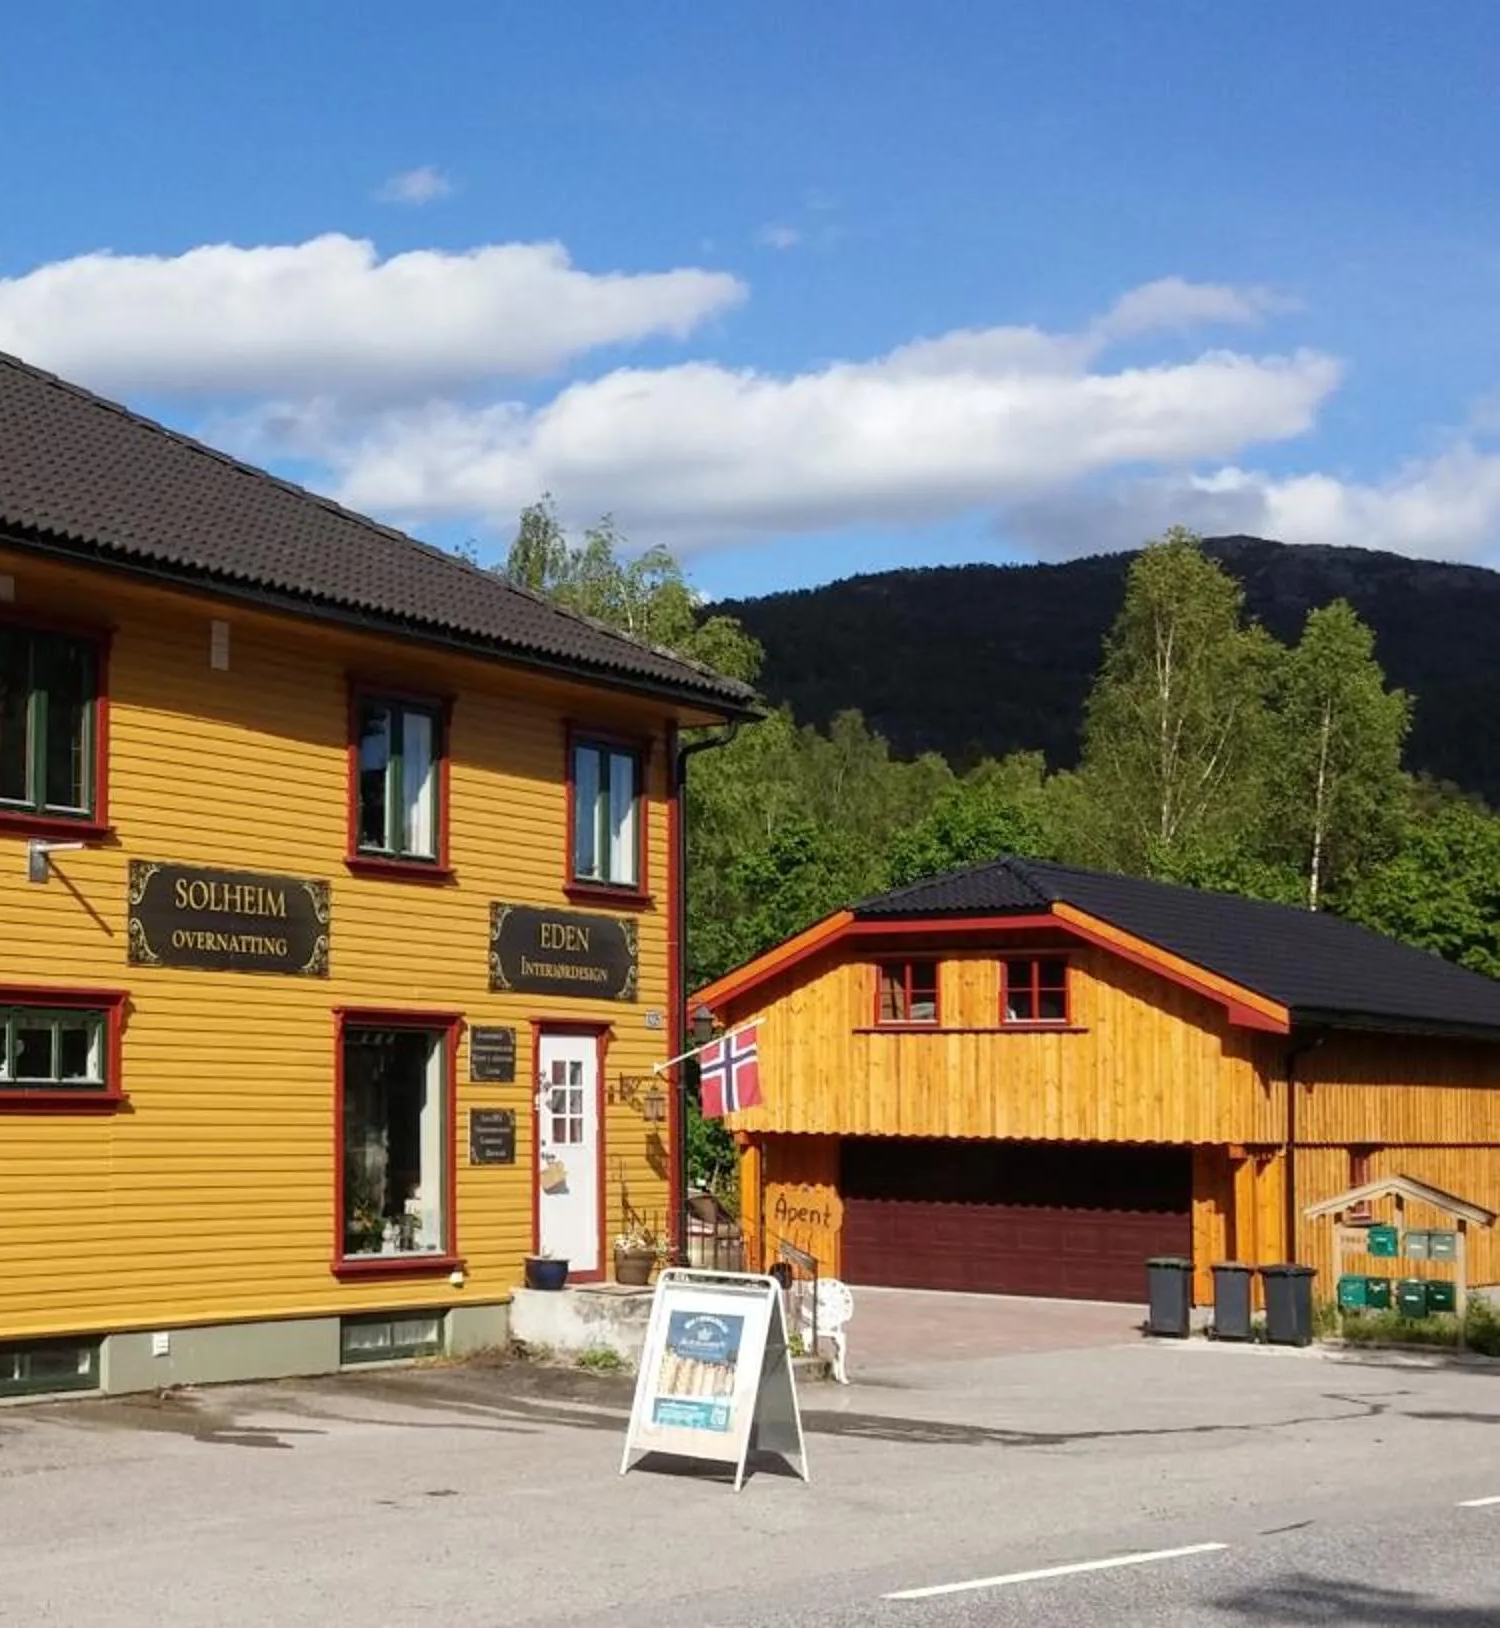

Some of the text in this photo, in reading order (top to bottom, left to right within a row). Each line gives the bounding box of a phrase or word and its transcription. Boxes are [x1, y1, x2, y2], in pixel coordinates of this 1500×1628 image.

[175, 878, 287, 918] SOLHEIM
[172, 929, 288, 957] OVERNATTING
[540, 922, 591, 952] EDEN
[775, 1192, 833, 1229] Åpent
